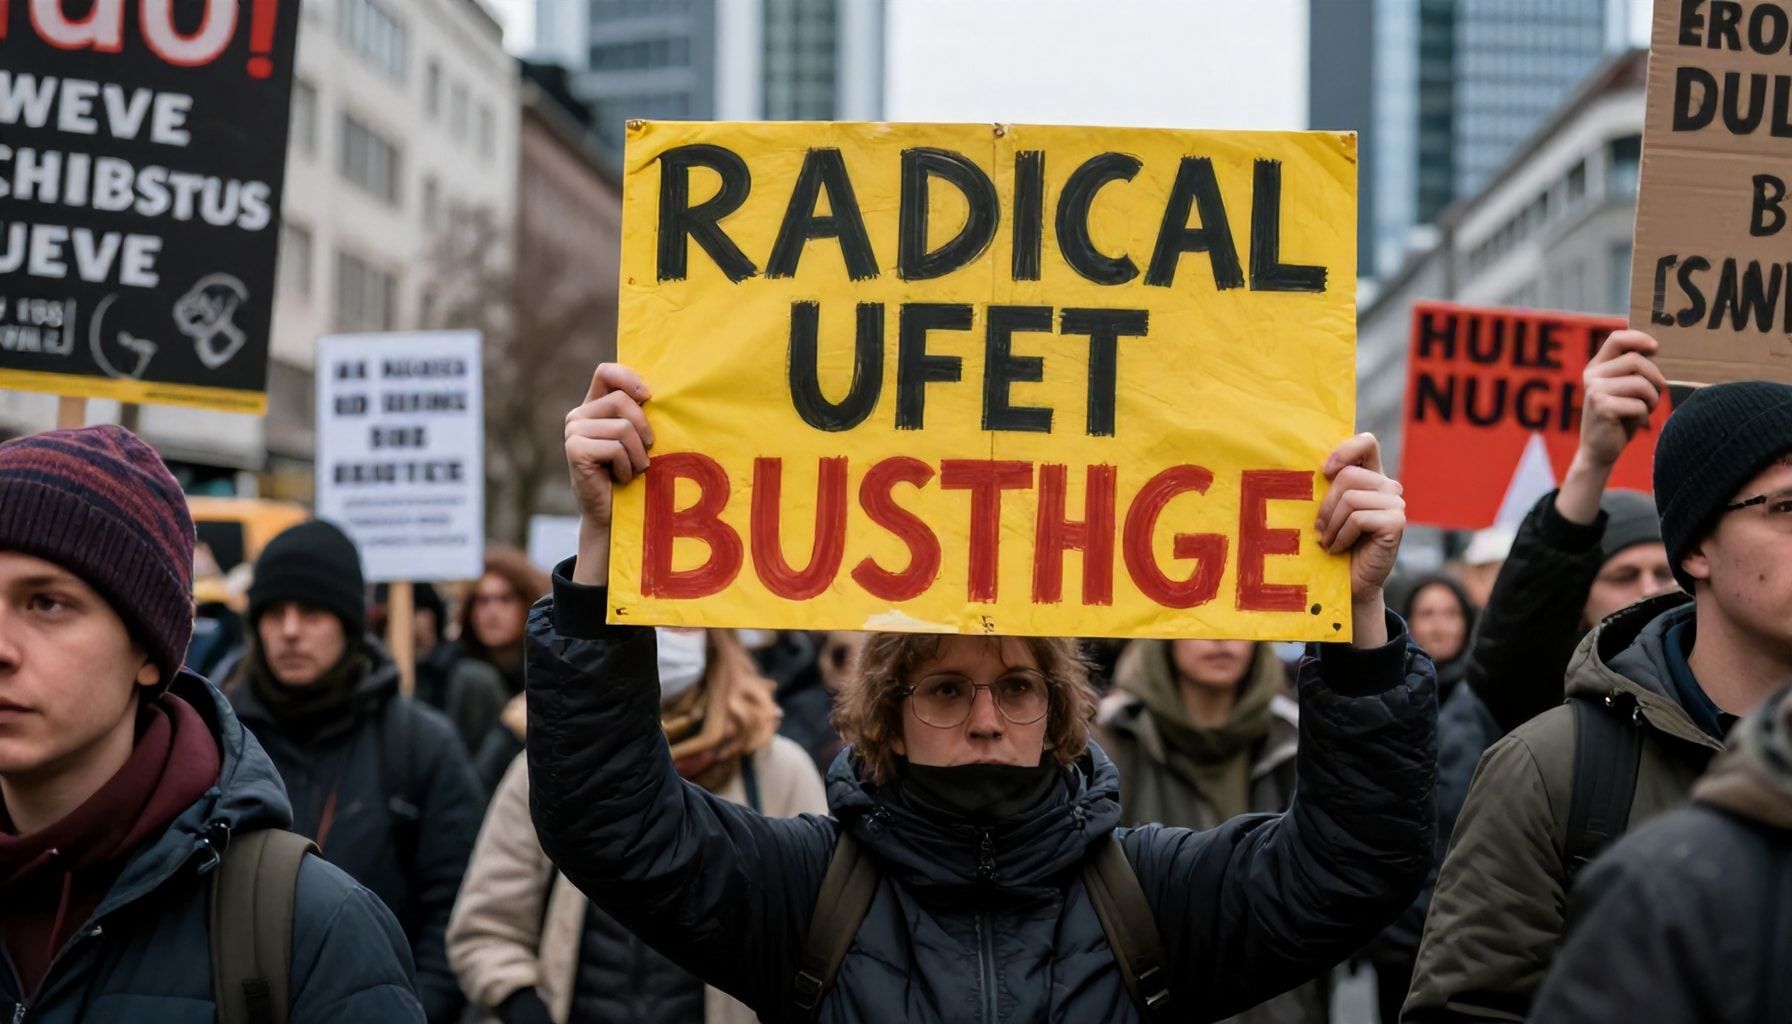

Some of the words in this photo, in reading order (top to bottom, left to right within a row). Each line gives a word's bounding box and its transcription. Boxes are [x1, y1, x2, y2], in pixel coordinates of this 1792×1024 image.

[1678, 0, 1792, 55] ERO
[656, 143, 1328, 292] RADICAL
[788, 300, 1149, 437] UFET
[1417, 311, 1563, 371] HULE
[640, 451, 1315, 613] BUSTHGE
